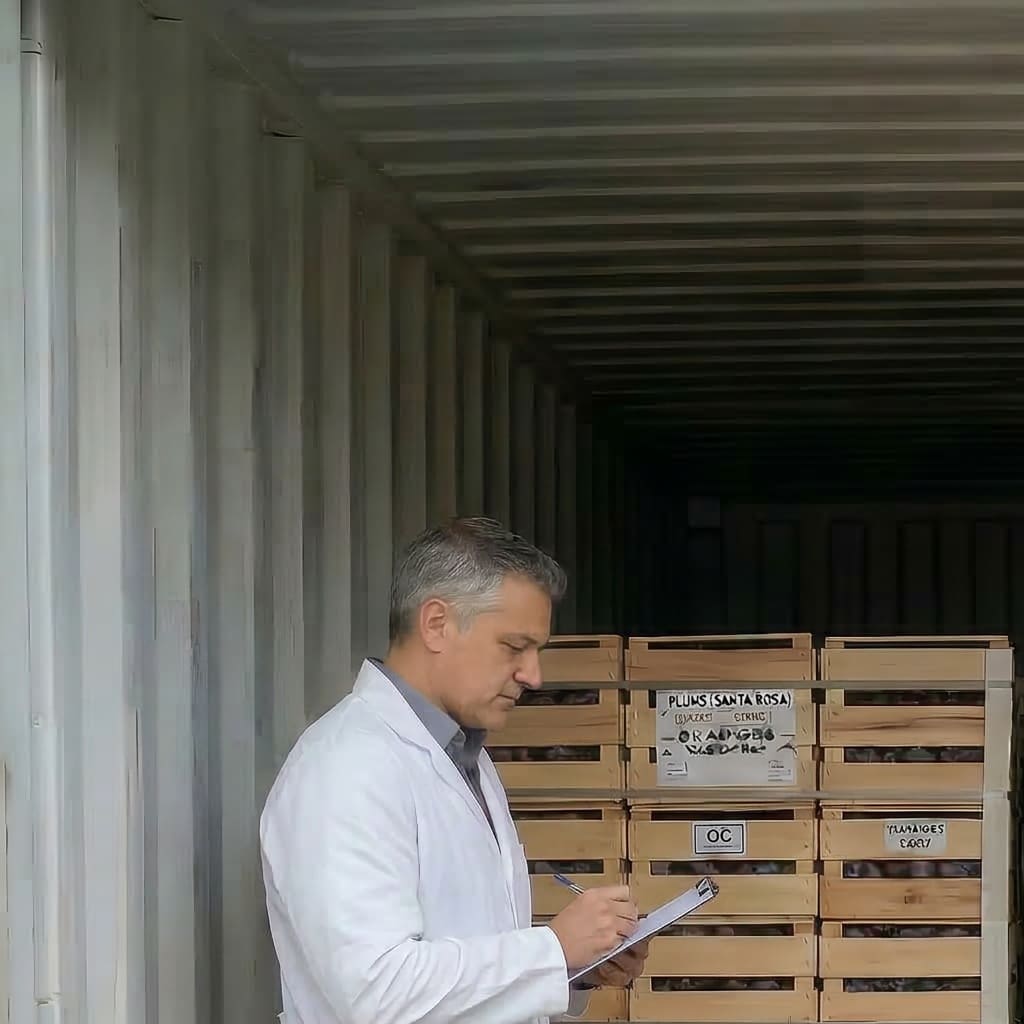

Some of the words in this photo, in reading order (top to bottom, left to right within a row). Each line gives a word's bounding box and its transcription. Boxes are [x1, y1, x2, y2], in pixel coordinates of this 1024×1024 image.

[668, 694, 707, 708] PLUMS
[709, 693, 753, 707] (SANTA
[755, 691, 792, 708] ROSA)
